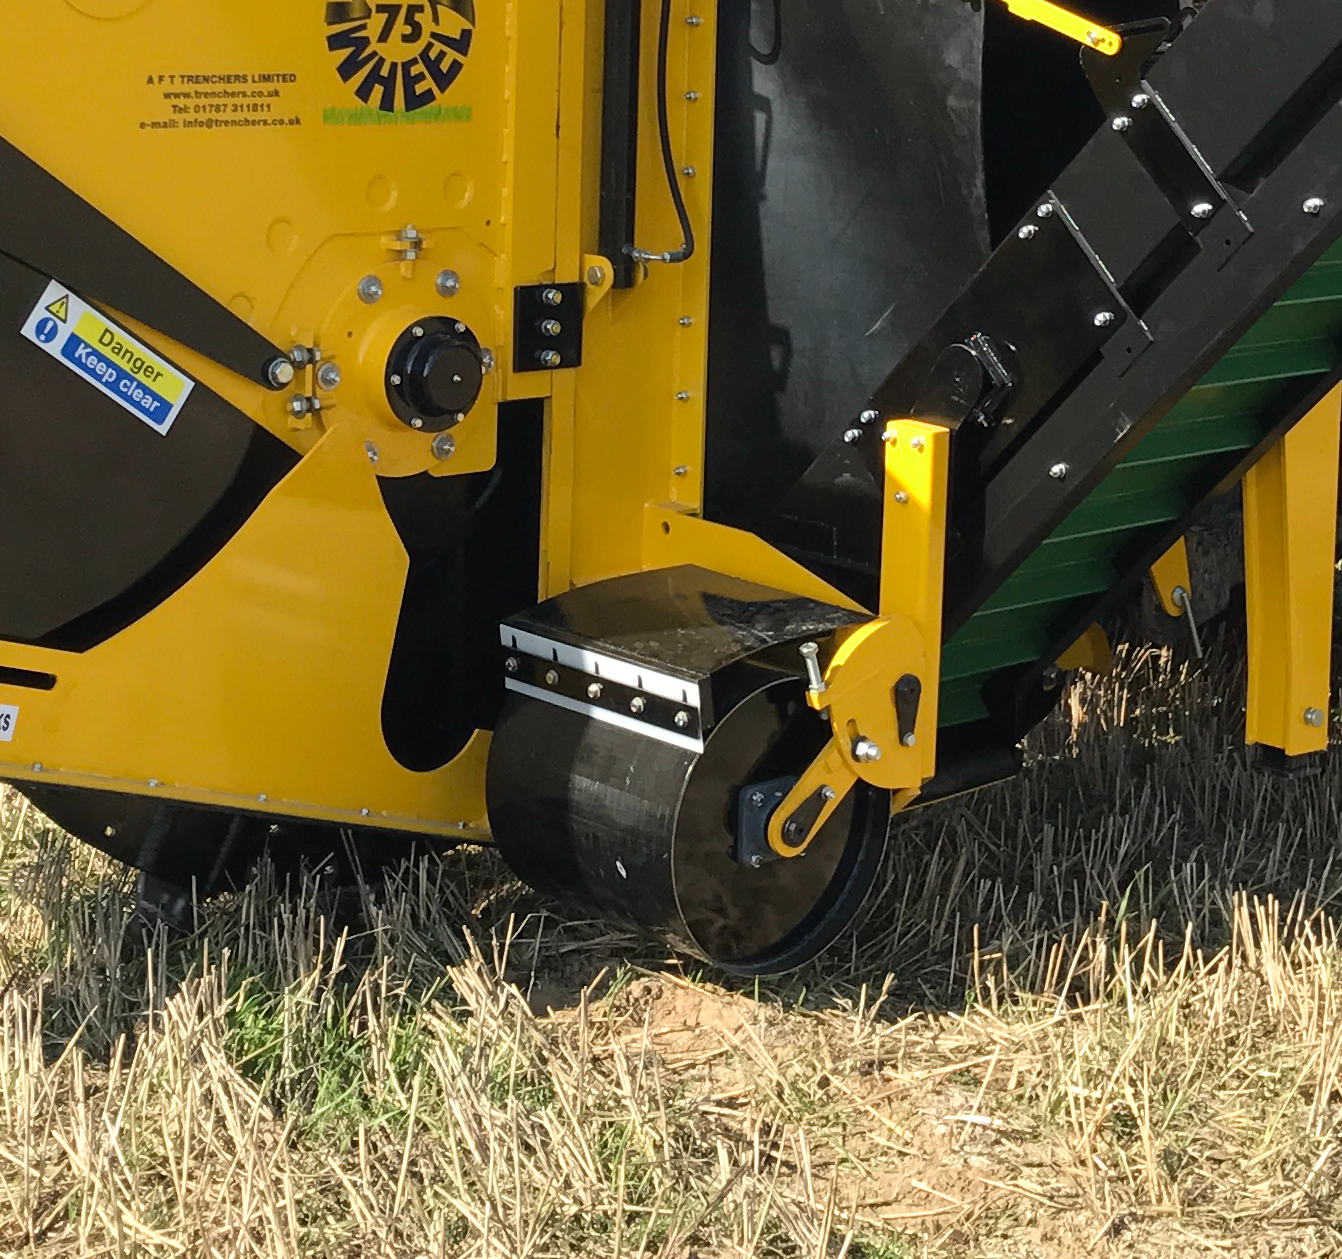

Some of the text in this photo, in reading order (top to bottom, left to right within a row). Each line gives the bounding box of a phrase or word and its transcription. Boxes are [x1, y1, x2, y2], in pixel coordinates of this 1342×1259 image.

[375, 3, 425, 44] 75
[146, 73, 297, 85] A F T TRENCHERS LIMITED
[326, 22, 473, 113] WHEEL
[163, 89, 280, 100] www.trenchers.co.uk
[193, 103, 228, 114] 01787
[139, 119, 180, 130] e-mail:
[97, 327, 164, 384] Danger
[74, 342, 161, 412] Keep clear
